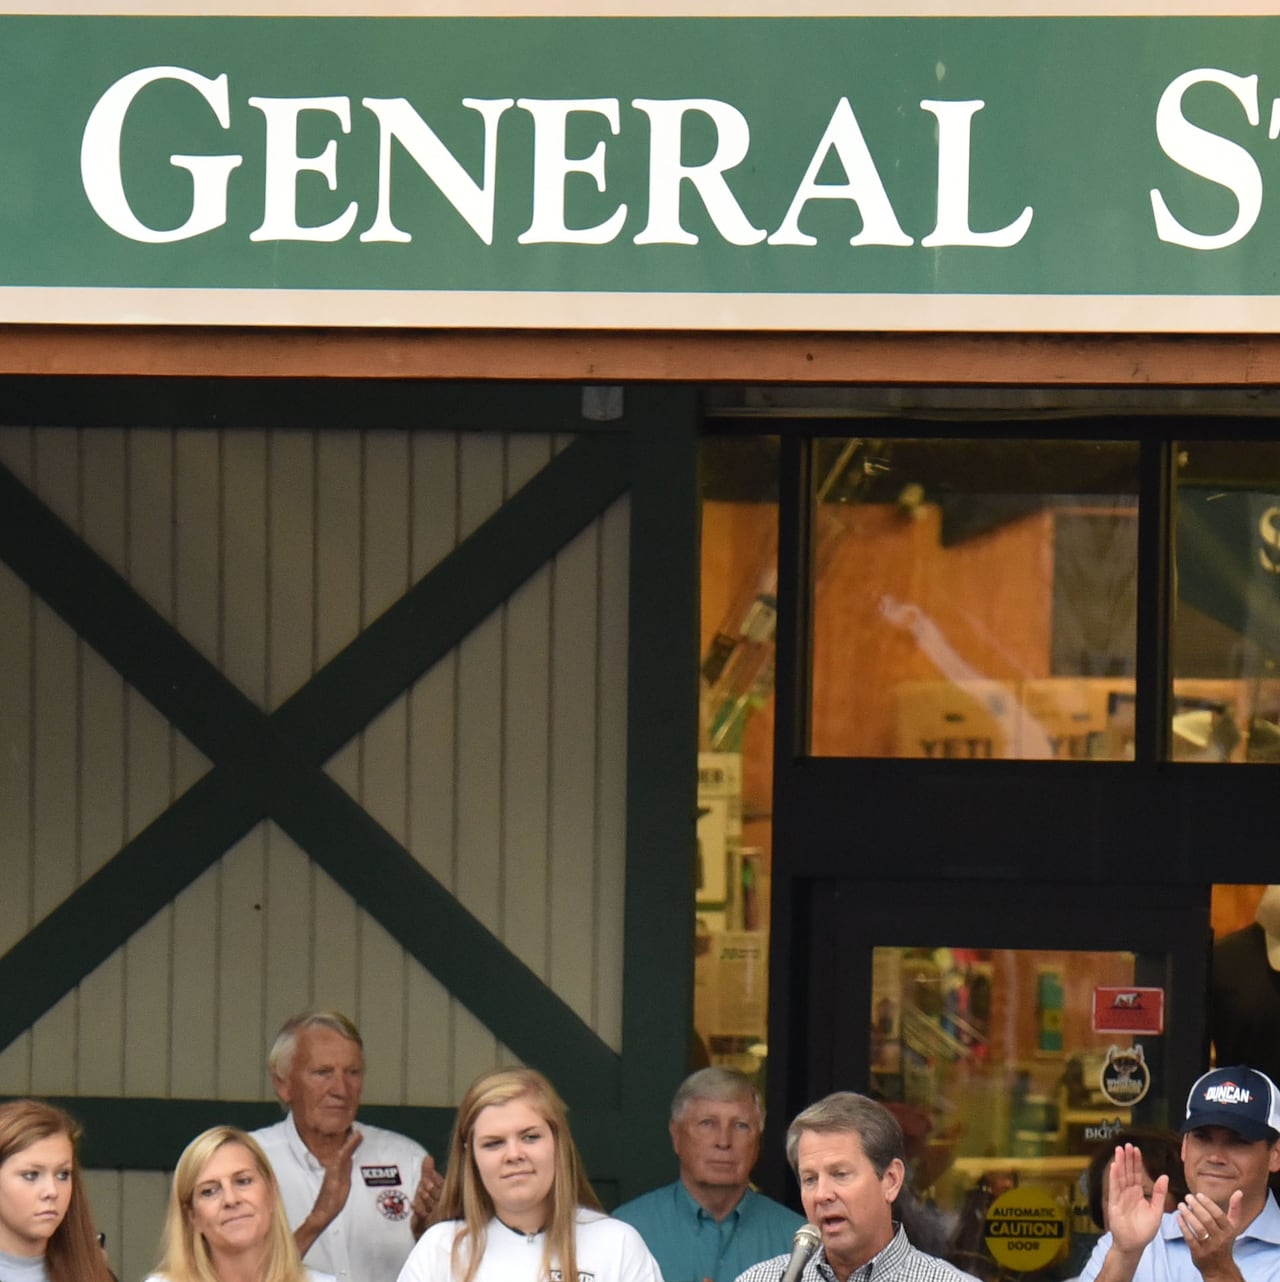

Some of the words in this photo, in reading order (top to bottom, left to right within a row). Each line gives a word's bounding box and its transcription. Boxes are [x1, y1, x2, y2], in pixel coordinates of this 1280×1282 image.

[80, 65, 1034, 248] GENERAL
[1205, 1085, 1250, 1104] DUNCAN
[993, 1207, 1056, 1217] AUTOMATIC
[989, 1221, 1059, 1236] CAUTION
[1007, 1241, 1039, 1251] DOOR
